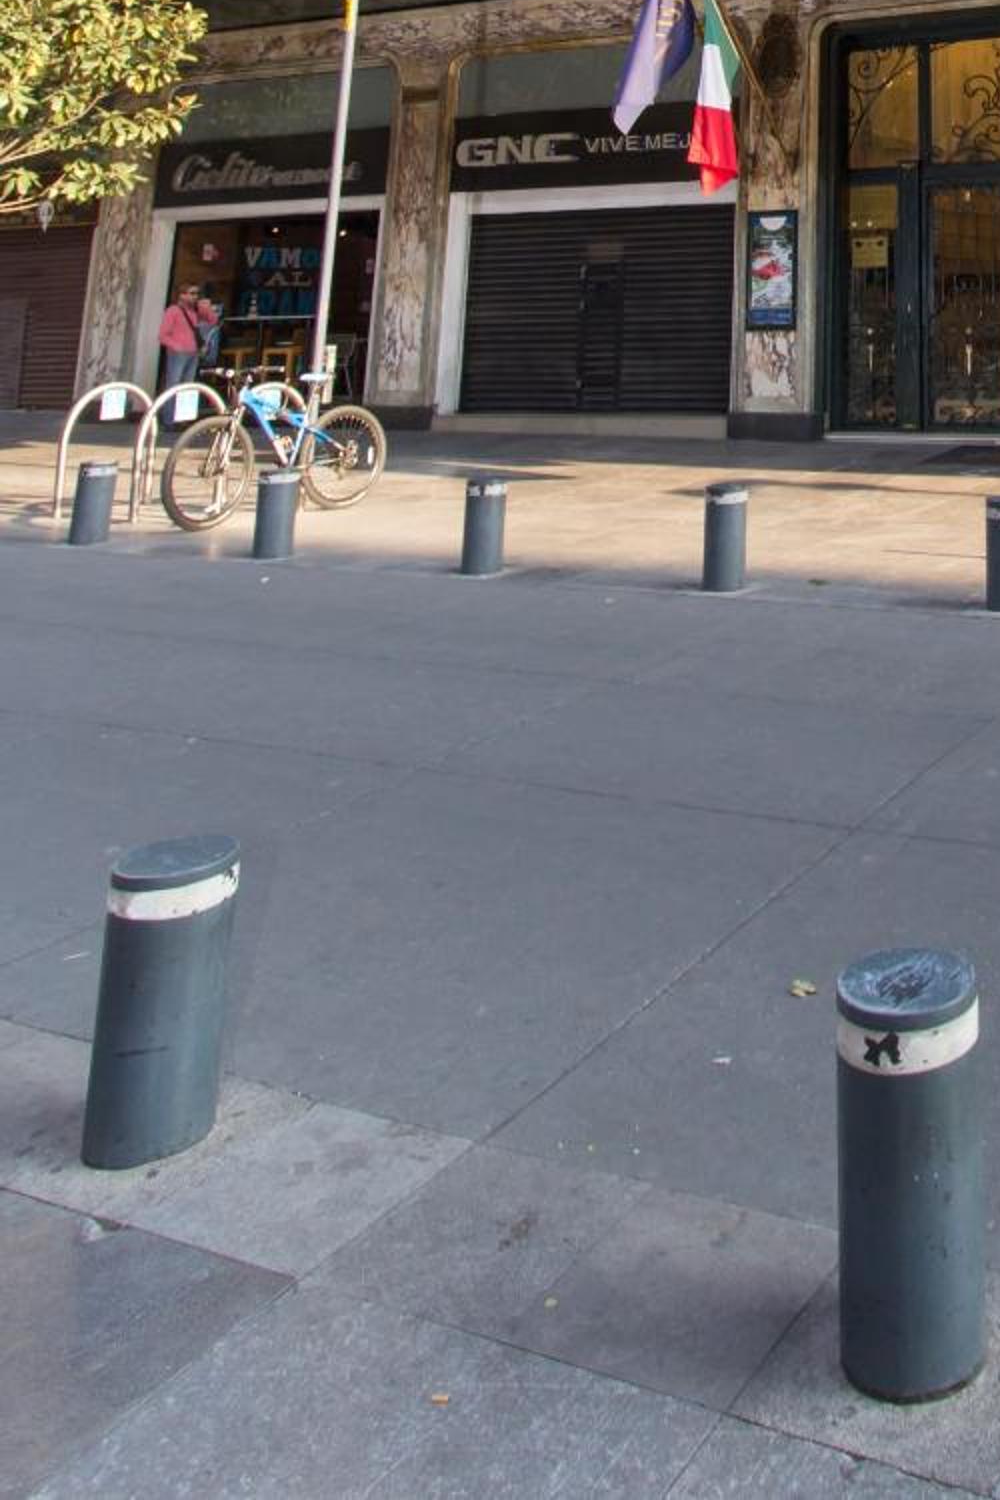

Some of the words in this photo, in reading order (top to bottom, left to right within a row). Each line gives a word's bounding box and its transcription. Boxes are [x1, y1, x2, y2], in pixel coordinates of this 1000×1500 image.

[456, 132, 579, 167] GNC
[586, 135, 639, 153] VIVE
[645, 131, 691, 150] MEJ
[244, 246, 321, 269] VAMO
[264, 272, 312, 287] AL
